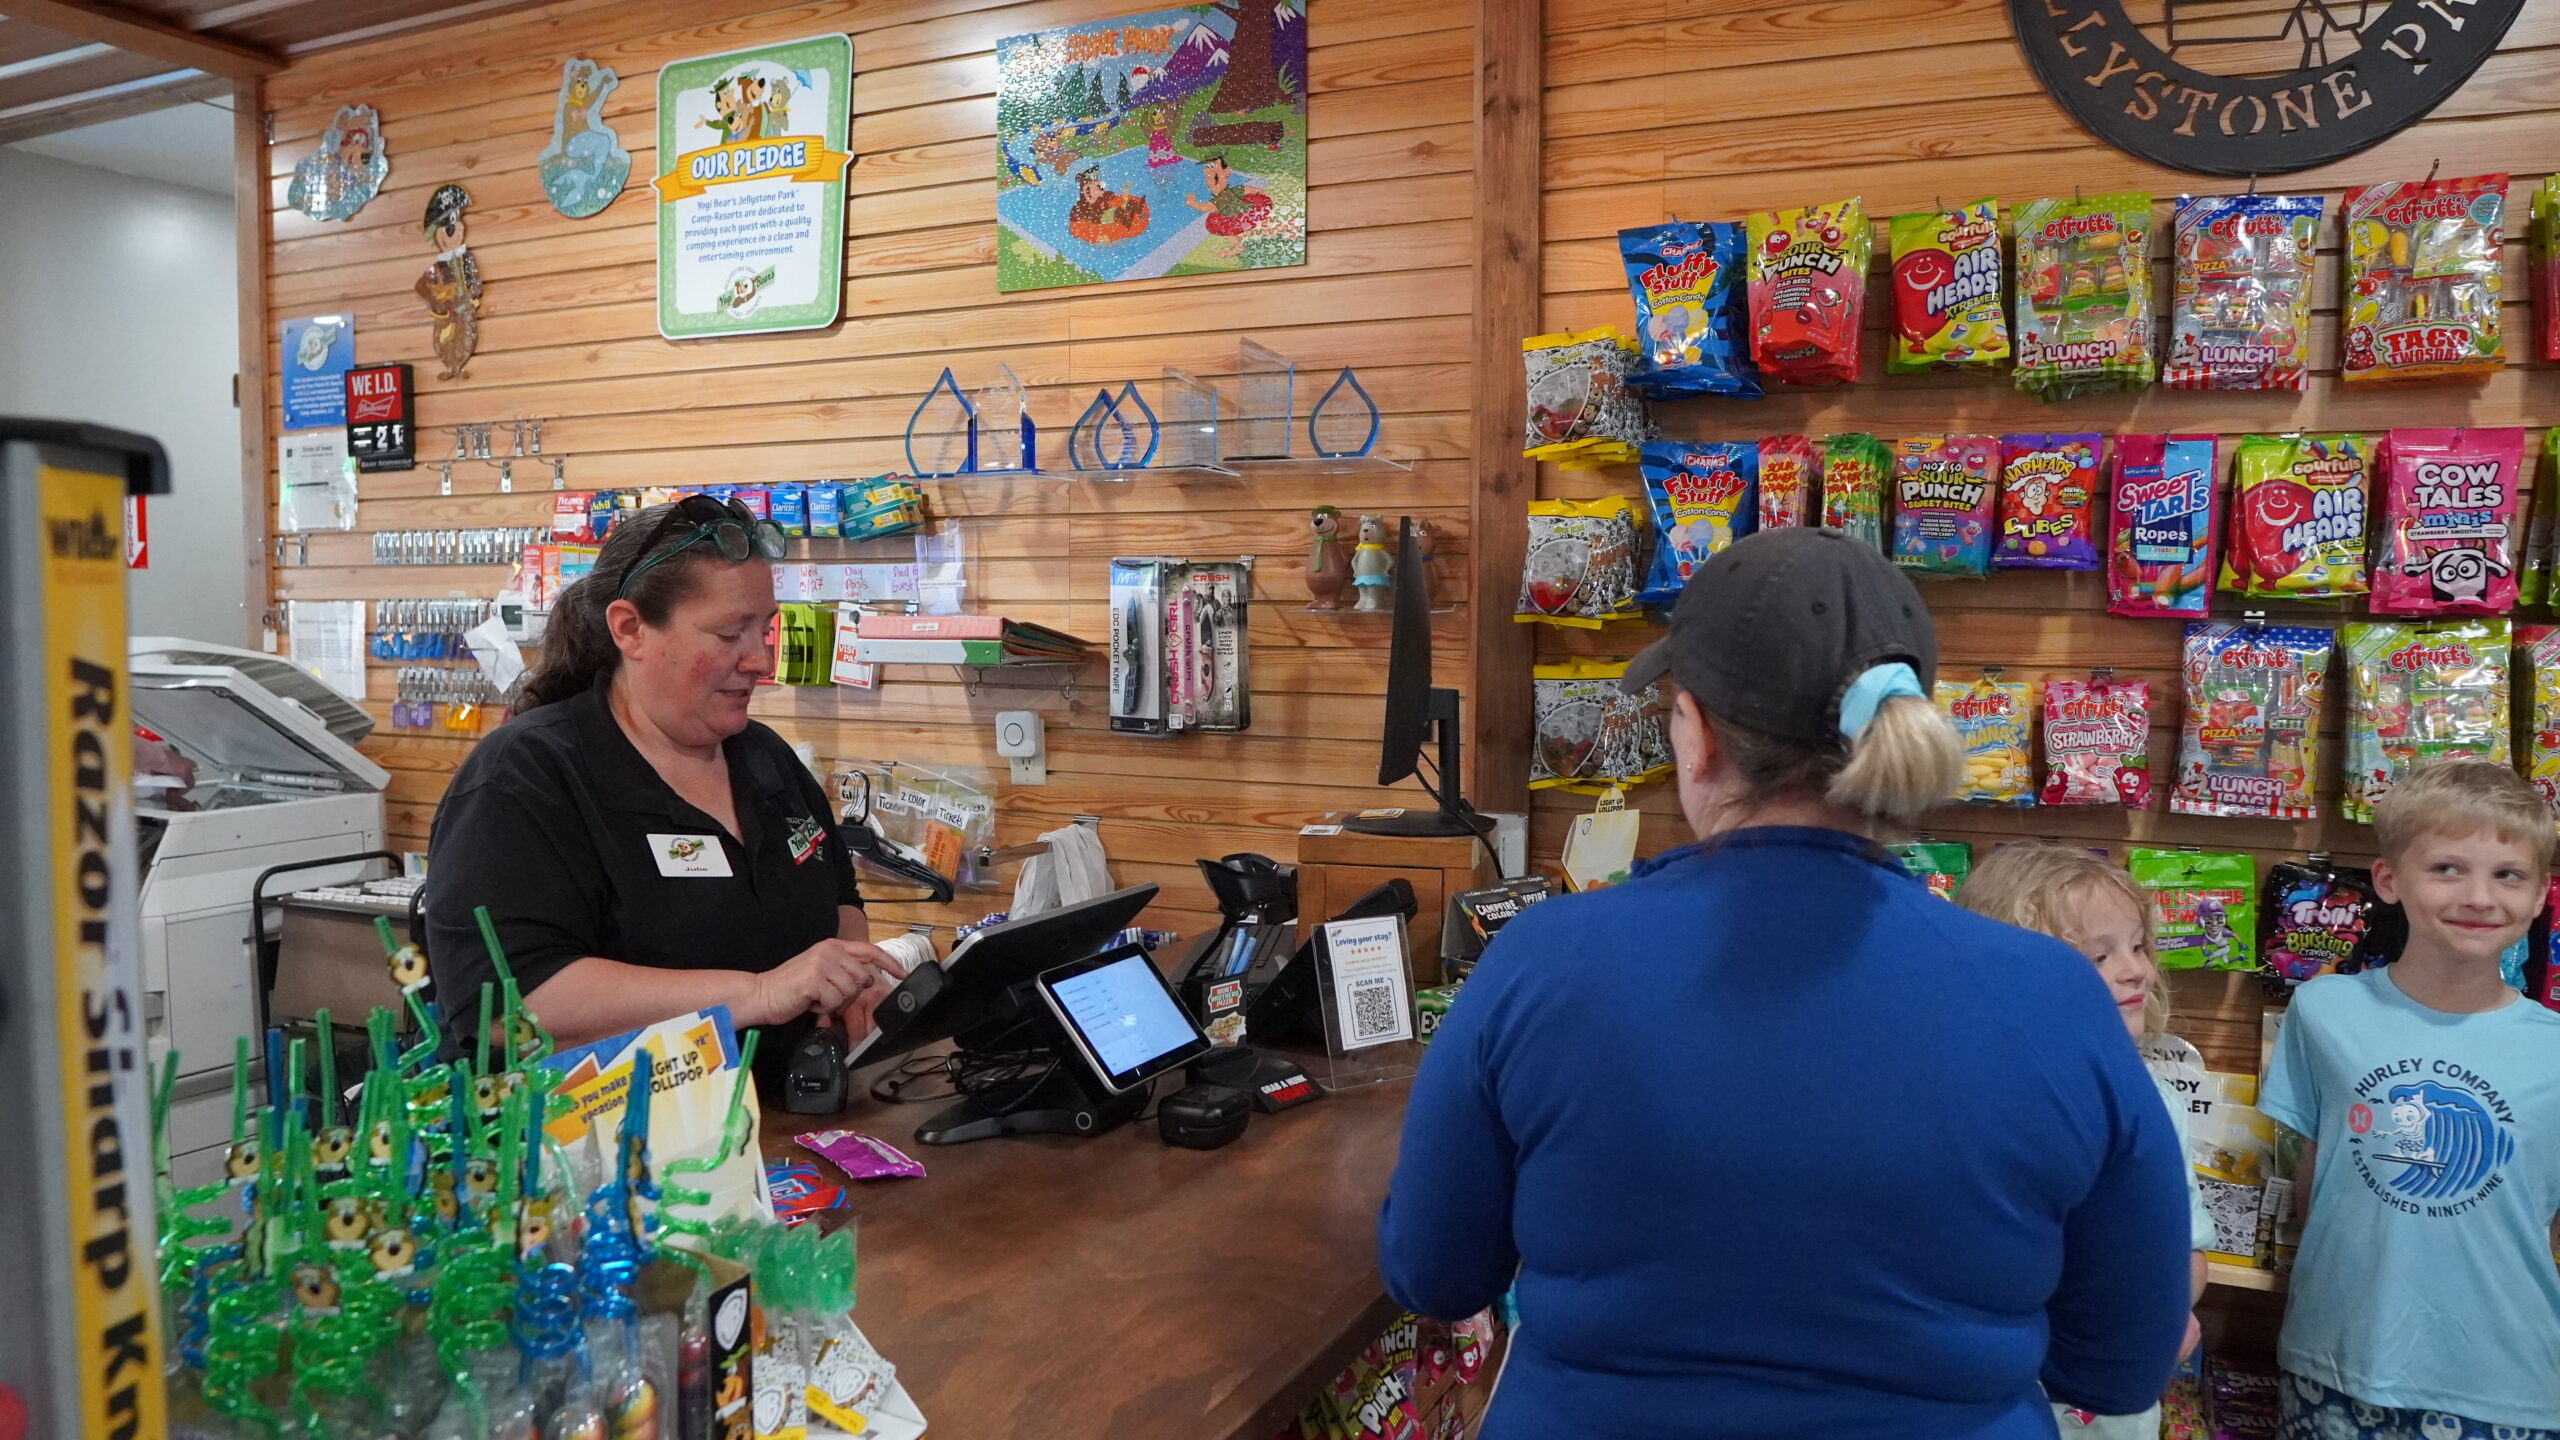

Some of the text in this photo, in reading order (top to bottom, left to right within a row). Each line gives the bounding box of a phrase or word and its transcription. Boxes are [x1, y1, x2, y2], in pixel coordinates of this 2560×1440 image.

[691, 141, 806, 180] OUR PLEDGE
[697, 200, 712, 211] Yogi
[713, 197, 736, 209] Bear's
[738, 193, 776, 207] Jellystone
[2385, 196, 2468, 227] efrutti
[691, 203, 805, 224] Camp-Resorts are dedicated to
[684, 226, 718, 240] providing
[719, 224, 737, 235] each
[738, 222, 759, 234] guest
[760, 220, 778, 230] with
[784, 215, 812, 229] quality
[2043, 212, 2117, 242] efrutti
[2210, 214, 2285, 242] efrutti
[686, 240, 717, 252] camping
[717, 236, 758, 249] experience
[759, 234, 766, 243] in
[773, 232, 794, 241] clean
[795, 229, 810, 240] and
[1780, 241, 1824, 259] SOUR
[698, 245, 796, 263] entertaining environment.
[1953, 247, 1998, 281] AIR
[1640, 252, 1720, 288] Fluffy
[1761, 253, 1842, 285] PUNCH
[1781, 267, 1811, 279] BITES
[2194, 260, 2226, 271] PIZZA
[1651, 272, 1698, 296] Stuff
[1926, 270, 2000, 315] HEADS
[1651, 292, 1705, 308] Cotton Candy
[1945, 293, 2001, 320] XTREMES
[2069, 334, 2091, 342] SOUR
[2383, 329, 2469, 353] TACO
[2044, 340, 2116, 362] LUNCH
[2201, 345, 2277, 364] LUNCH
[351, 374, 373, 396] WE
[375, 372, 397, 394] I.D.
[1766, 462, 1795, 473] SOUR
[1832, 462, 1860, 473] SOUR
[1922, 461, 1963, 473] NOT SO
[2002, 457, 2074, 488] WARHEADS
[2292, 457, 2364, 476] sourfuls
[2416, 462, 2500, 487] COW
[1662, 470, 1749, 497] Fluffy
[1918, 470, 1966, 486] SOUR
[1676, 487, 1726, 506] Stuff
[1901, 481, 1984, 505] PUNCH
[2313, 488, 2364, 518] AIR
[2413, 484, 2503, 509] TALES
[591, 499, 611, 512] Advil
[771, 503, 795, 513] Claritin
[810, 502, 831, 513] Claritin
[1675, 507, 1732, 519] Cotton Candy
[1907, 499, 1972, 511] SWEET BITES
[2003, 513, 2074, 538] CUBES
[2423, 510, 2493, 528] minis
[2135, 526, 2189, 543] Ropes
[2282, 513, 2364, 554] HEADS
[2410, 529, 2449, 537] STRAWBERRY
[801, 565, 864, 579] Wed Day
[1192, 573, 1231, 582] CRUSH
[845, 579, 869, 590] Pass
[1112, 628, 1120, 665] POCKET
[1168, 600, 1180, 705] CRUSH GIRL
[2389, 642, 2473, 672] efrutti
[1112, 665, 1120, 695] KNIFE
[1951, 693, 2012, 721] efrutti
[2063, 695, 2127, 721] efrutti
[2052, 728, 2139, 750] STRAWBERRY
[2202, 727, 2237, 739] PIZZA
[2209, 776, 2284, 797] LUNCH
[70, 657, 115, 946] Razor
[1598, 804, 1624, 814] LOLLIPOP
[1600, 797, 1624, 807] LIGHT UP
[939, 807, 964, 827] Tickets
[1475, 899, 1520, 916] CAMPFIRE
[2174, 889, 2245, 906] LEAGUE
[1486, 910, 1517, 921] COLORS
[2293, 901, 2358, 927] Trolli
[1335, 931, 1392, 947] Loving your stay?
[2176, 926, 2195, 934] GUM
[2170, 940, 2189, 948] Apple
[2287, 931, 2355, 957] Bursting
[1355, 979, 1373, 988] SCAN
[1216, 999, 1233, 1008] PIZZA
[683, 1051, 699, 1067] UP
[650, 1066, 704, 1096] OLLIPOP
[1260, 1082, 1282, 1095] GRAB
[2354, 1057, 2515, 1125] HURLEY COMPANY
[580, 1076, 628, 1108] you make
[581, 1096, 625, 1124] vacation
[80, 987, 134, 1291] Sharp
[2352, 1149, 2505, 1218] ESTABLISHED NINETY-NINE
[1358, 1372, 1407, 1436] PUNCH
